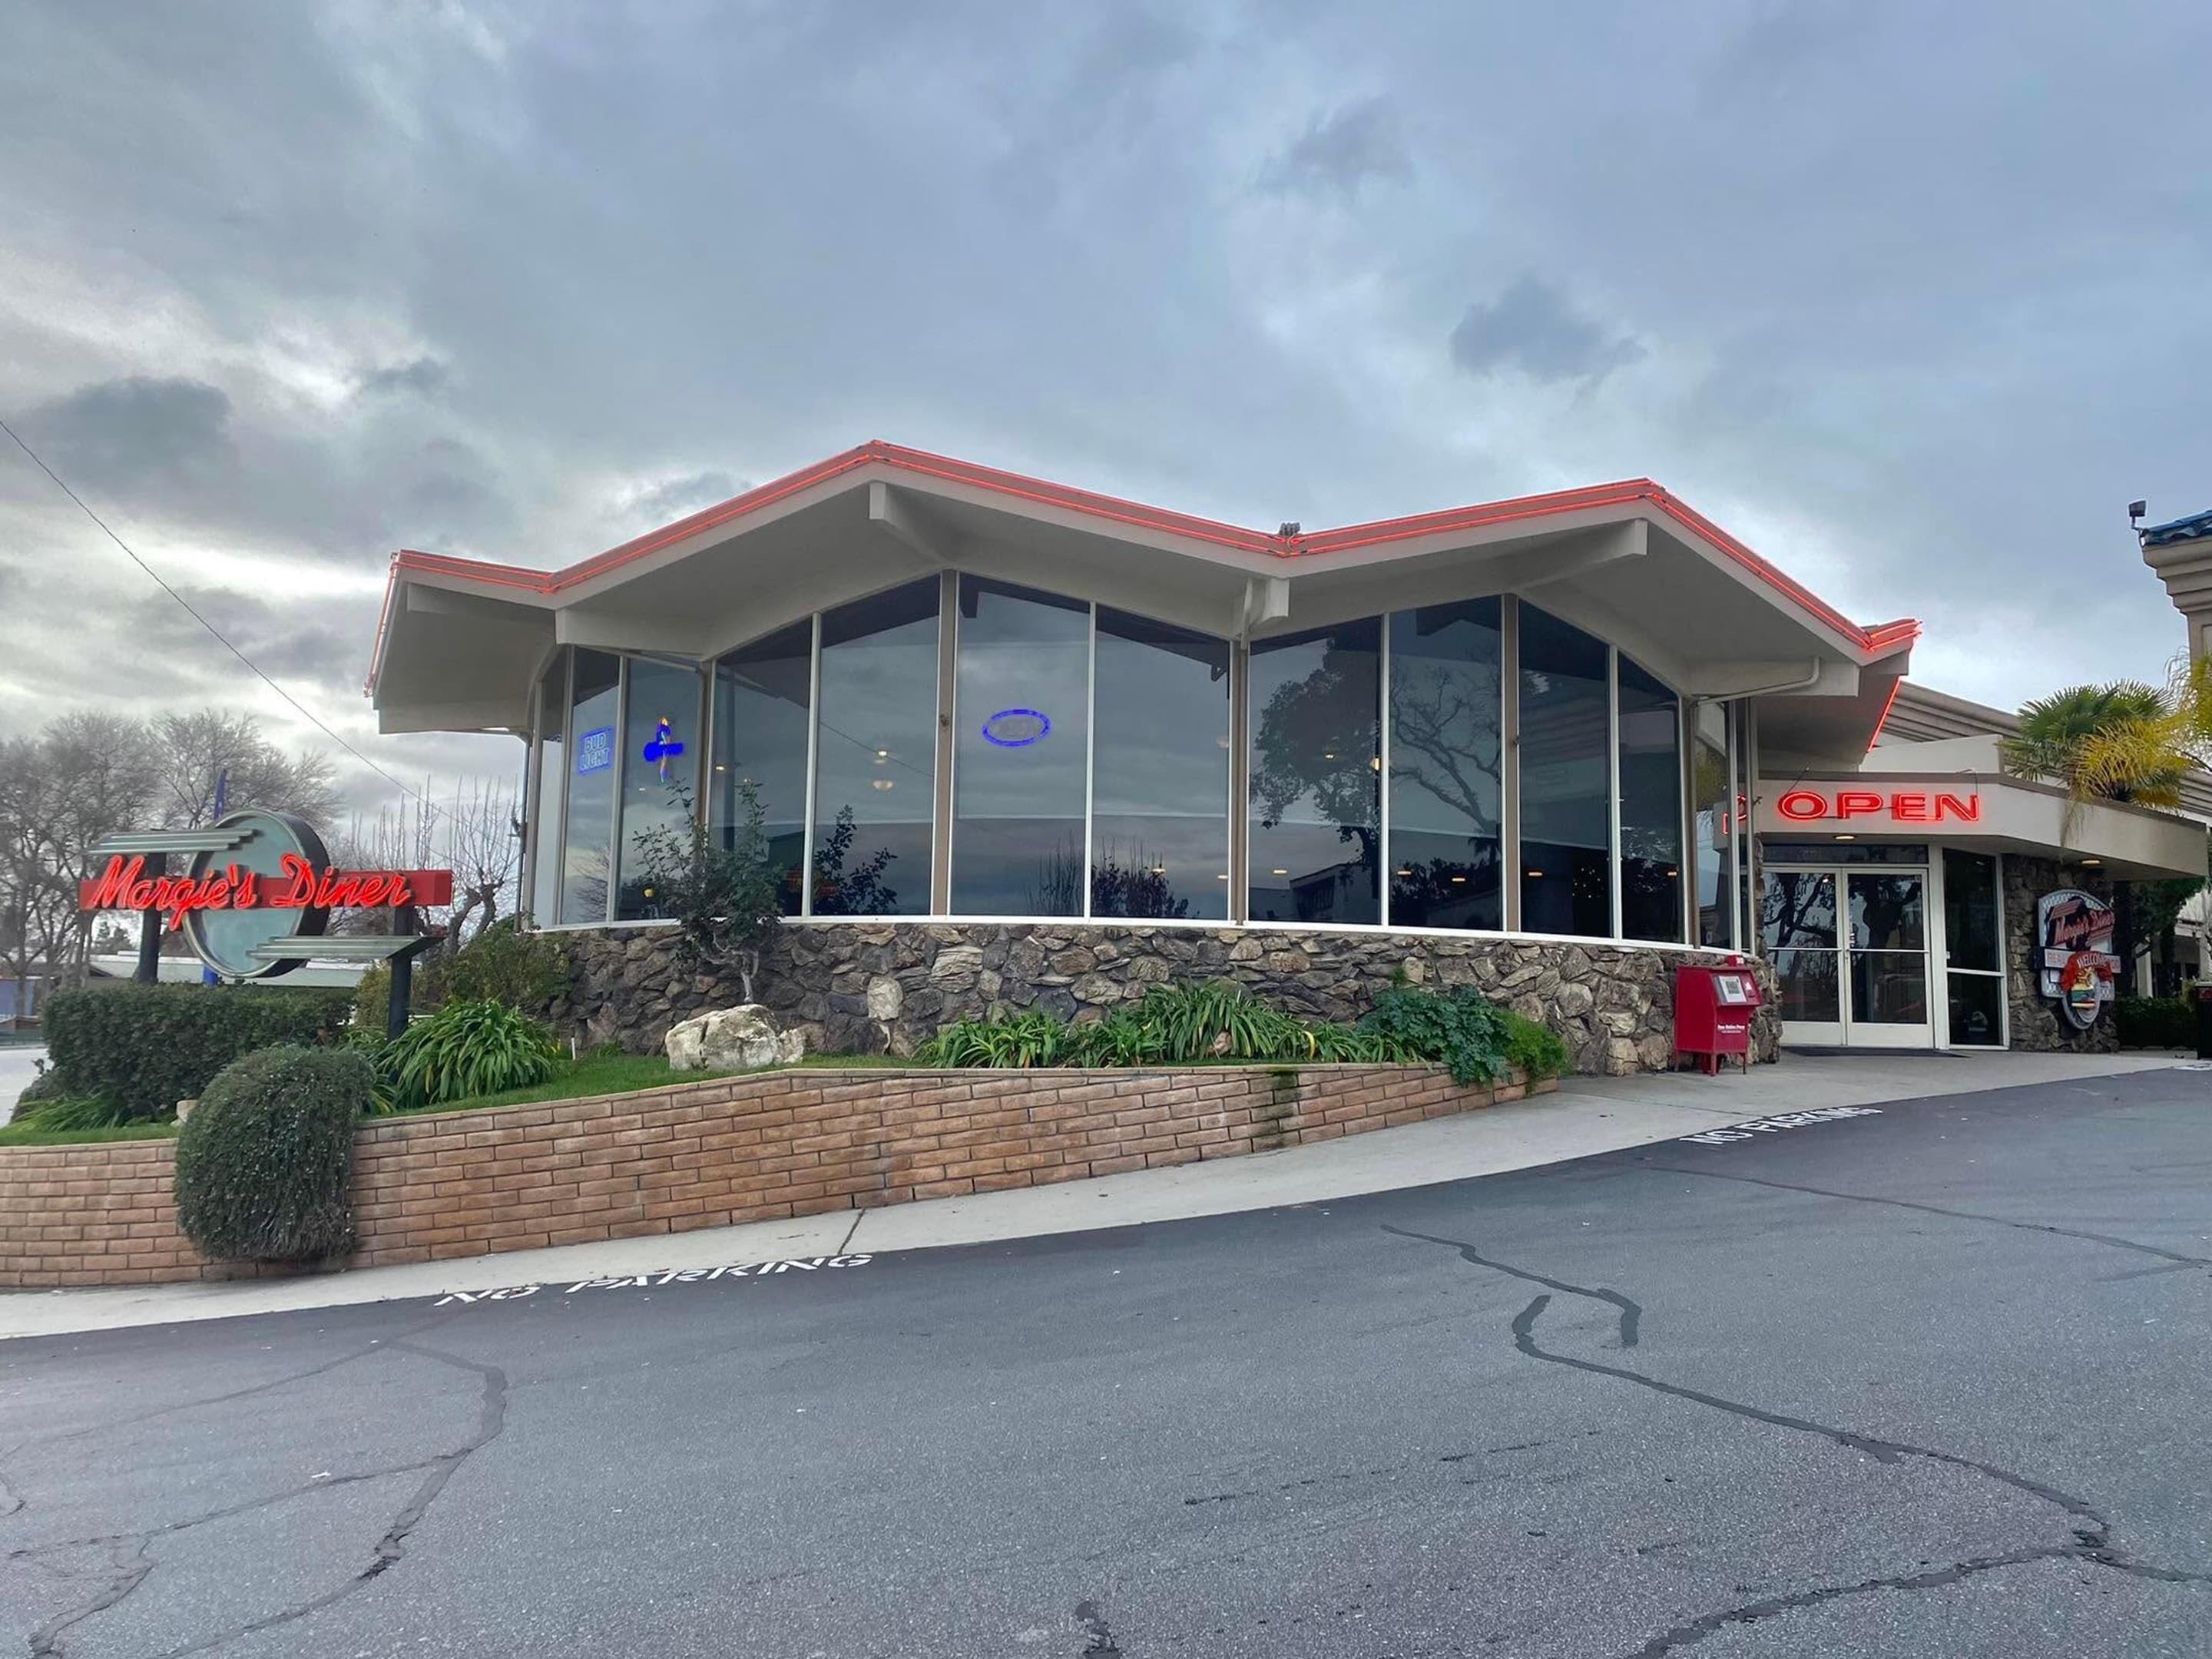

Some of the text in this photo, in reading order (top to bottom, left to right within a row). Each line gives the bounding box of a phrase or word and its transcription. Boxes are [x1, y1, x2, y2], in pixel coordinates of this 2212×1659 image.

[580, 747, 610, 771] LIGHT
[584, 732, 607, 753] BUD
[1777, 791, 1979, 821] OPEN
[89, 853, 411, 931] Margie's Diner
[1679, 1107, 1883, 1145] NO PARKING
[434, 1253, 873, 1306] NO PARKING
